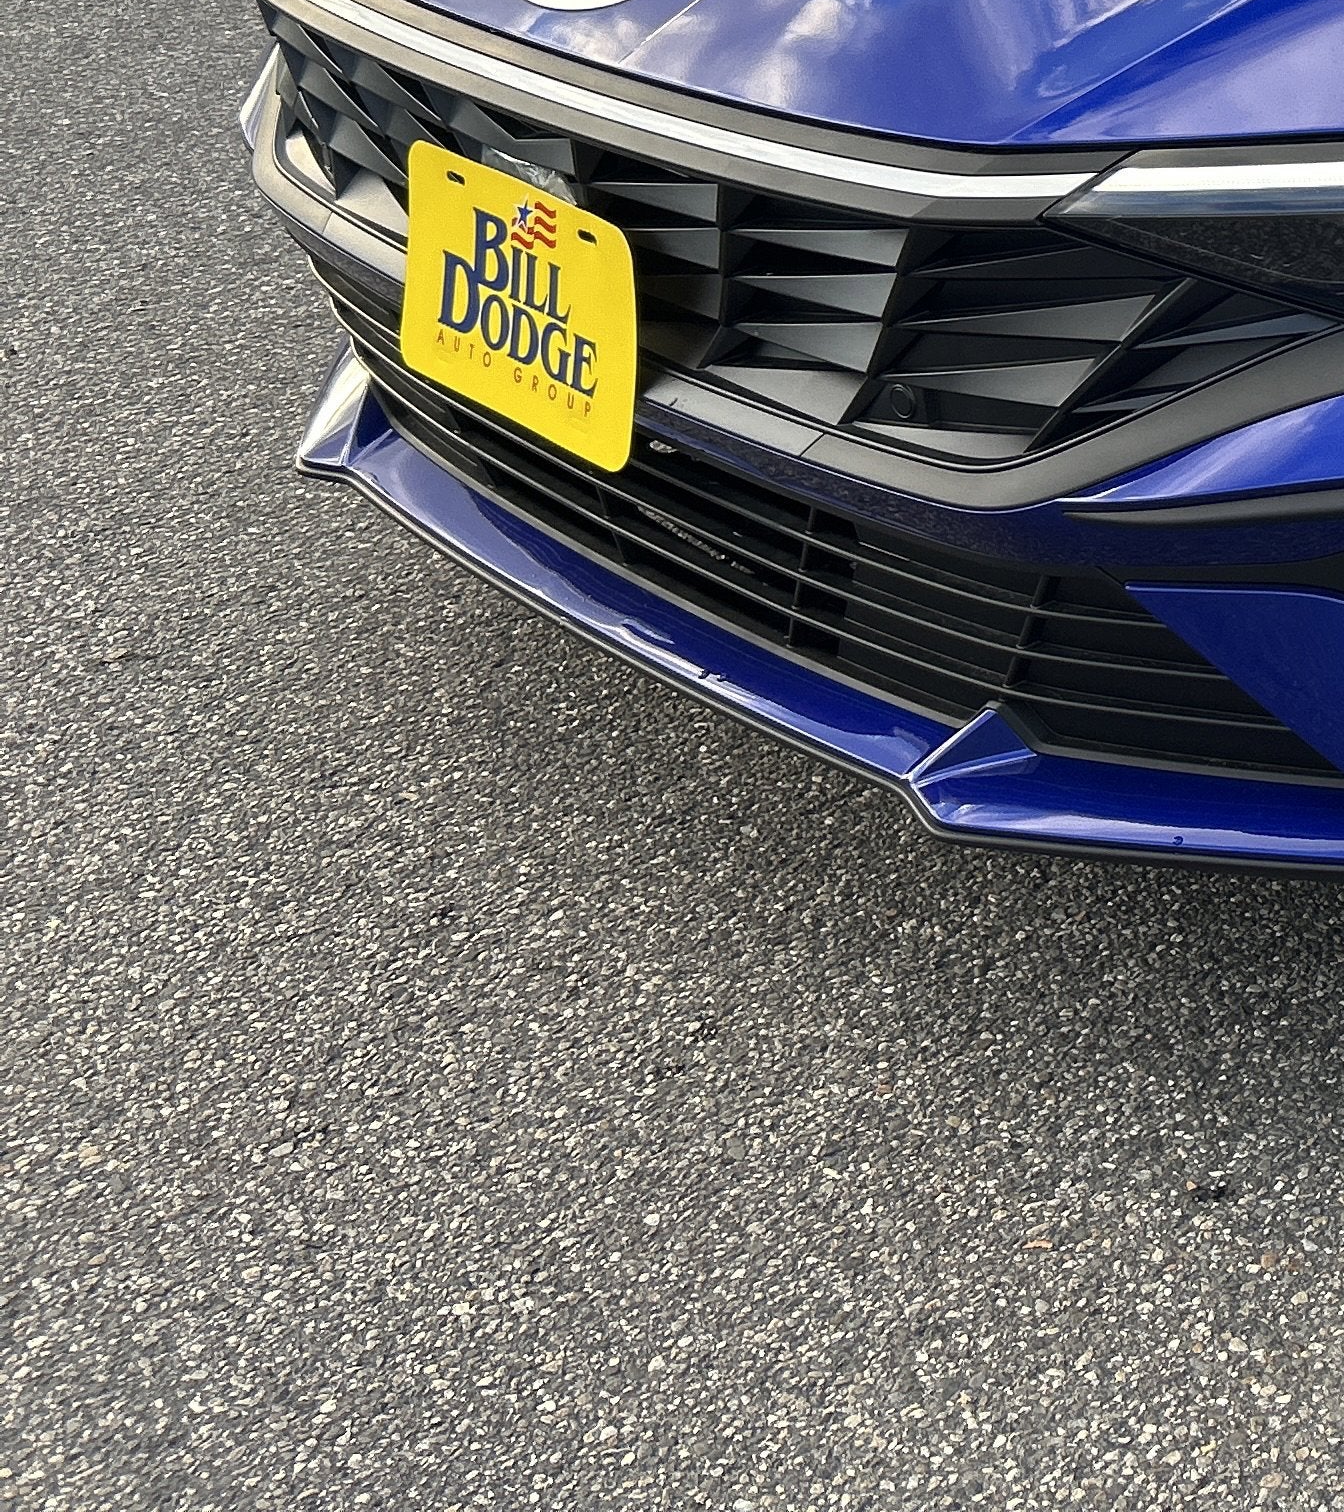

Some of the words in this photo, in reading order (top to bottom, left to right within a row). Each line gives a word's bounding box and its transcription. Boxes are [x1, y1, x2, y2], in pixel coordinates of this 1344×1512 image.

[437, 249, 598, 400] DODGE
[472, 206, 572, 325] BILL
[436, 328, 492, 368] AUTO
[513, 366, 594, 419] GROUP
